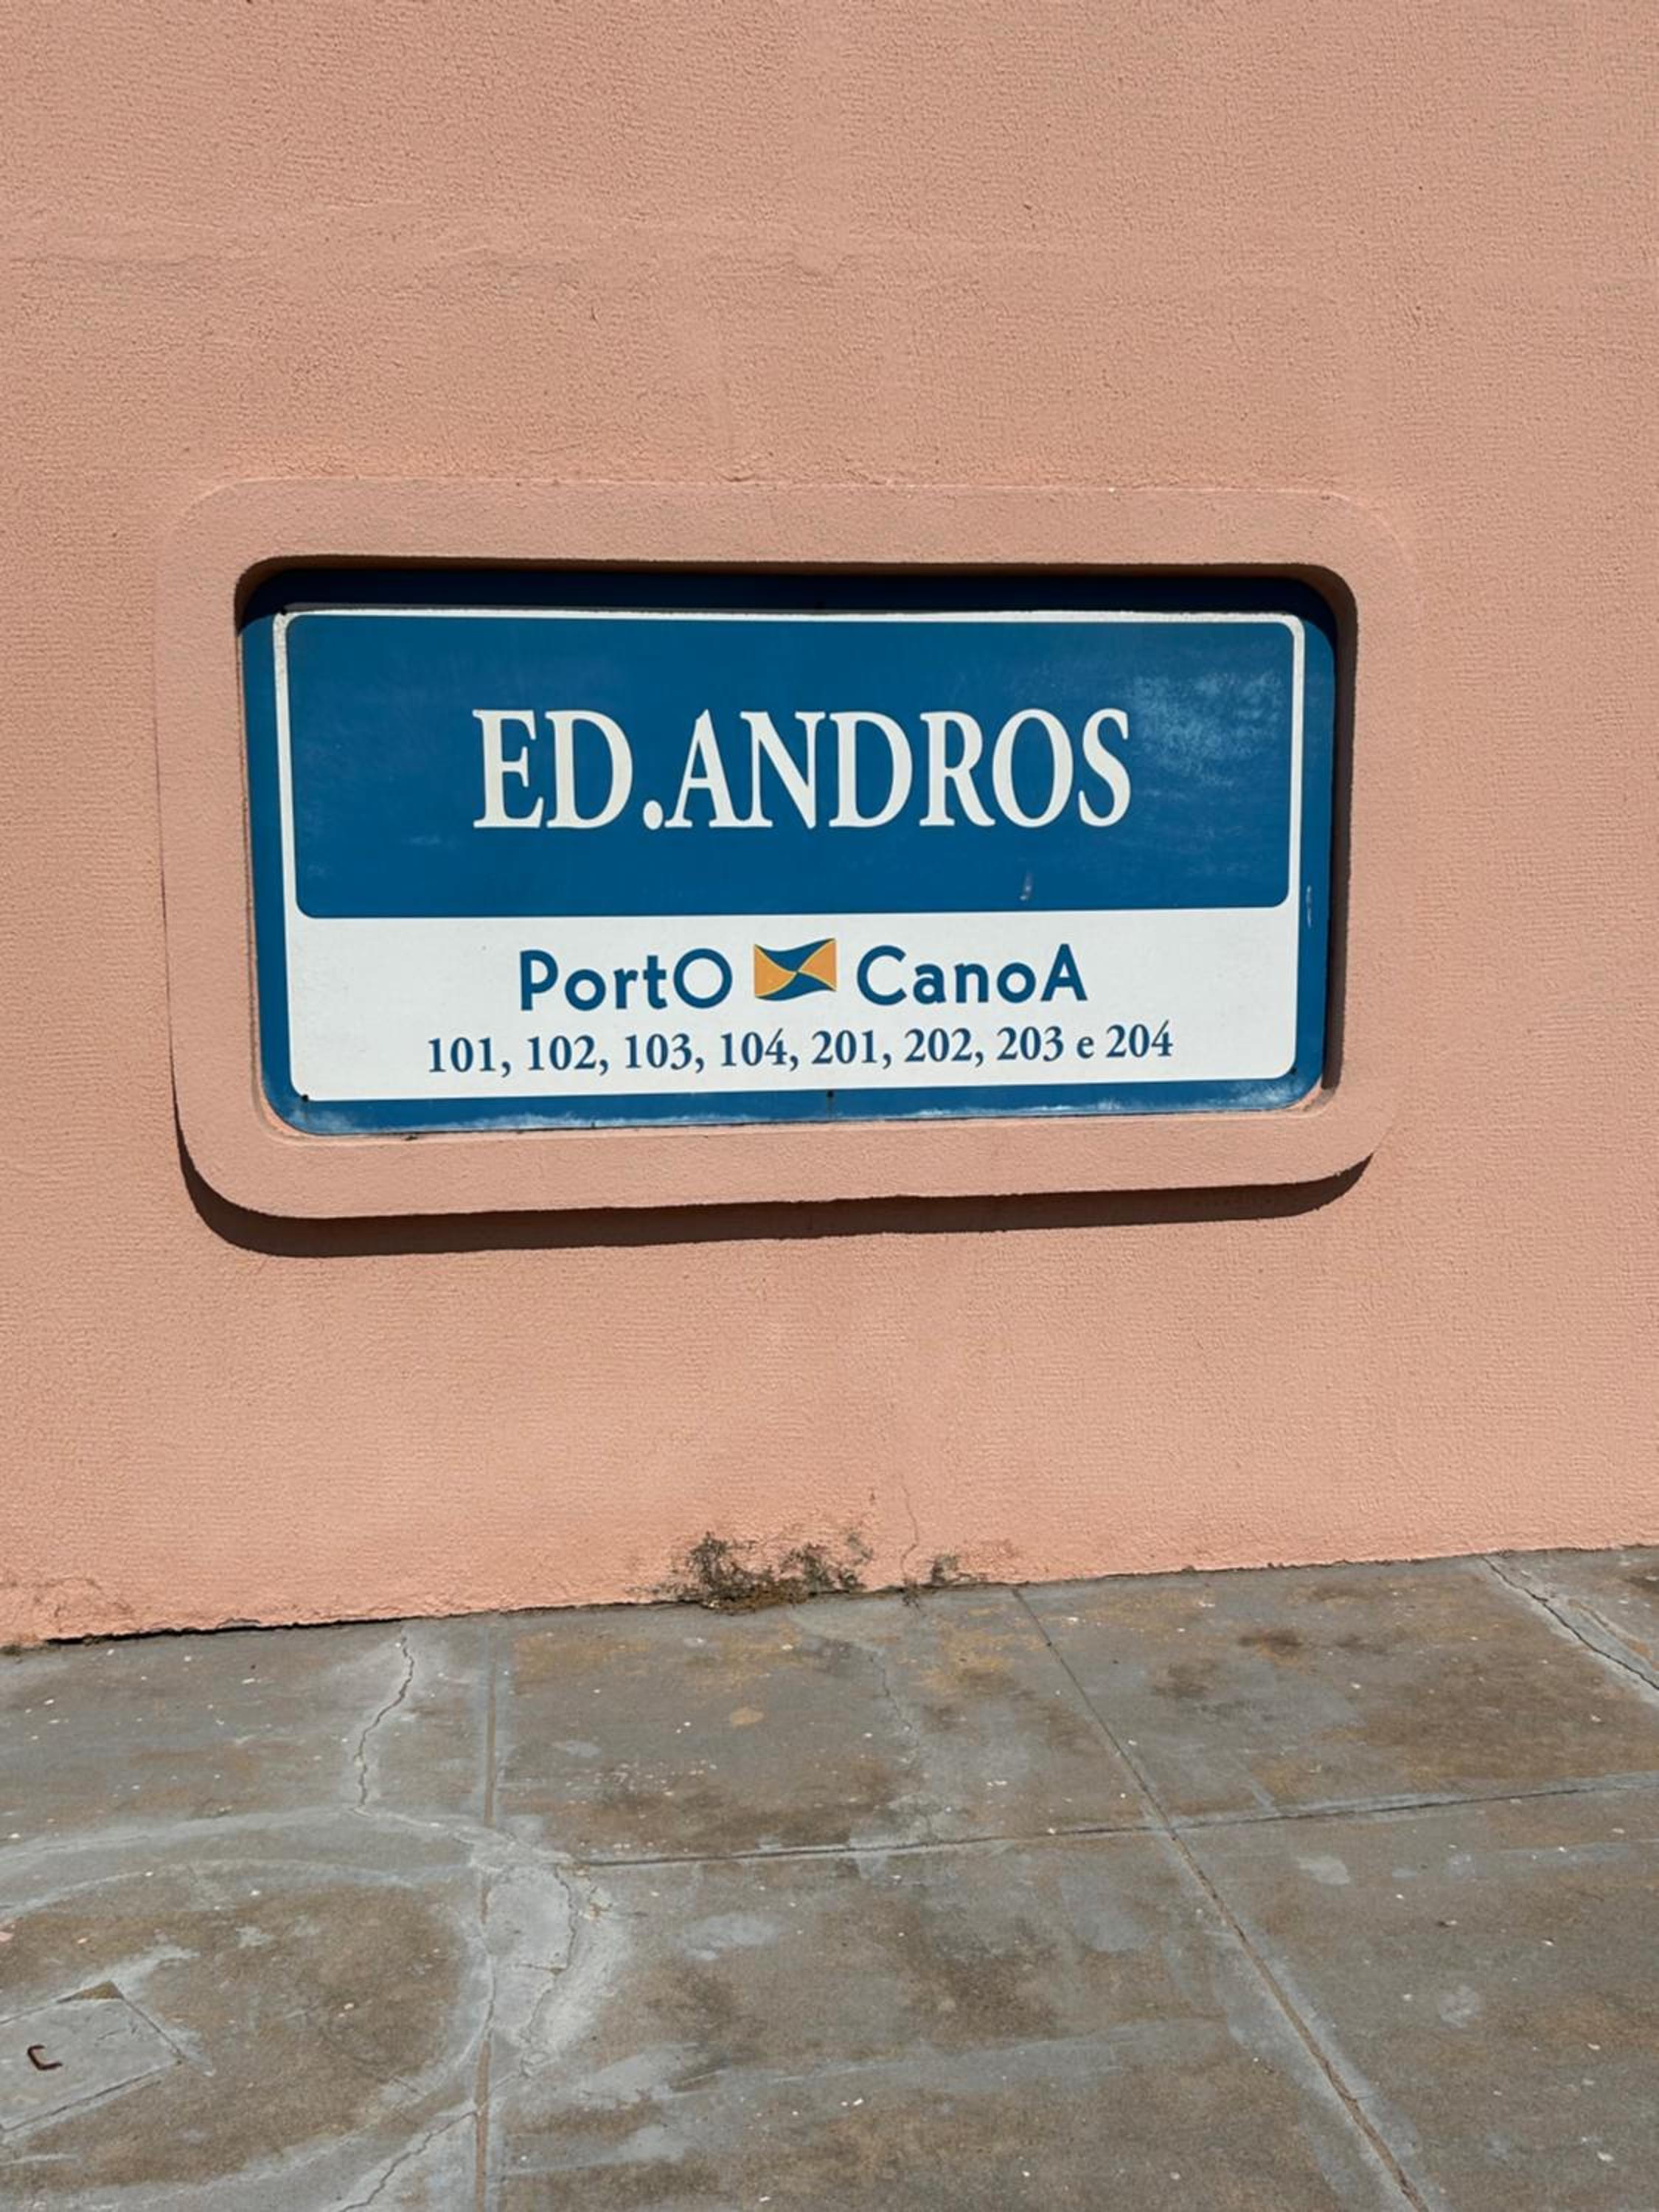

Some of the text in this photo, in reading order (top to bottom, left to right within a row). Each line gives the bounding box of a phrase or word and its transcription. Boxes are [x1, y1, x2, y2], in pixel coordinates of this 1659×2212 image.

[520, 944, 1088, 1011] PortO CanoA
[429, 1020, 1172, 1077] 101, 102, 103, 104, 201, 202, 203 e 204
